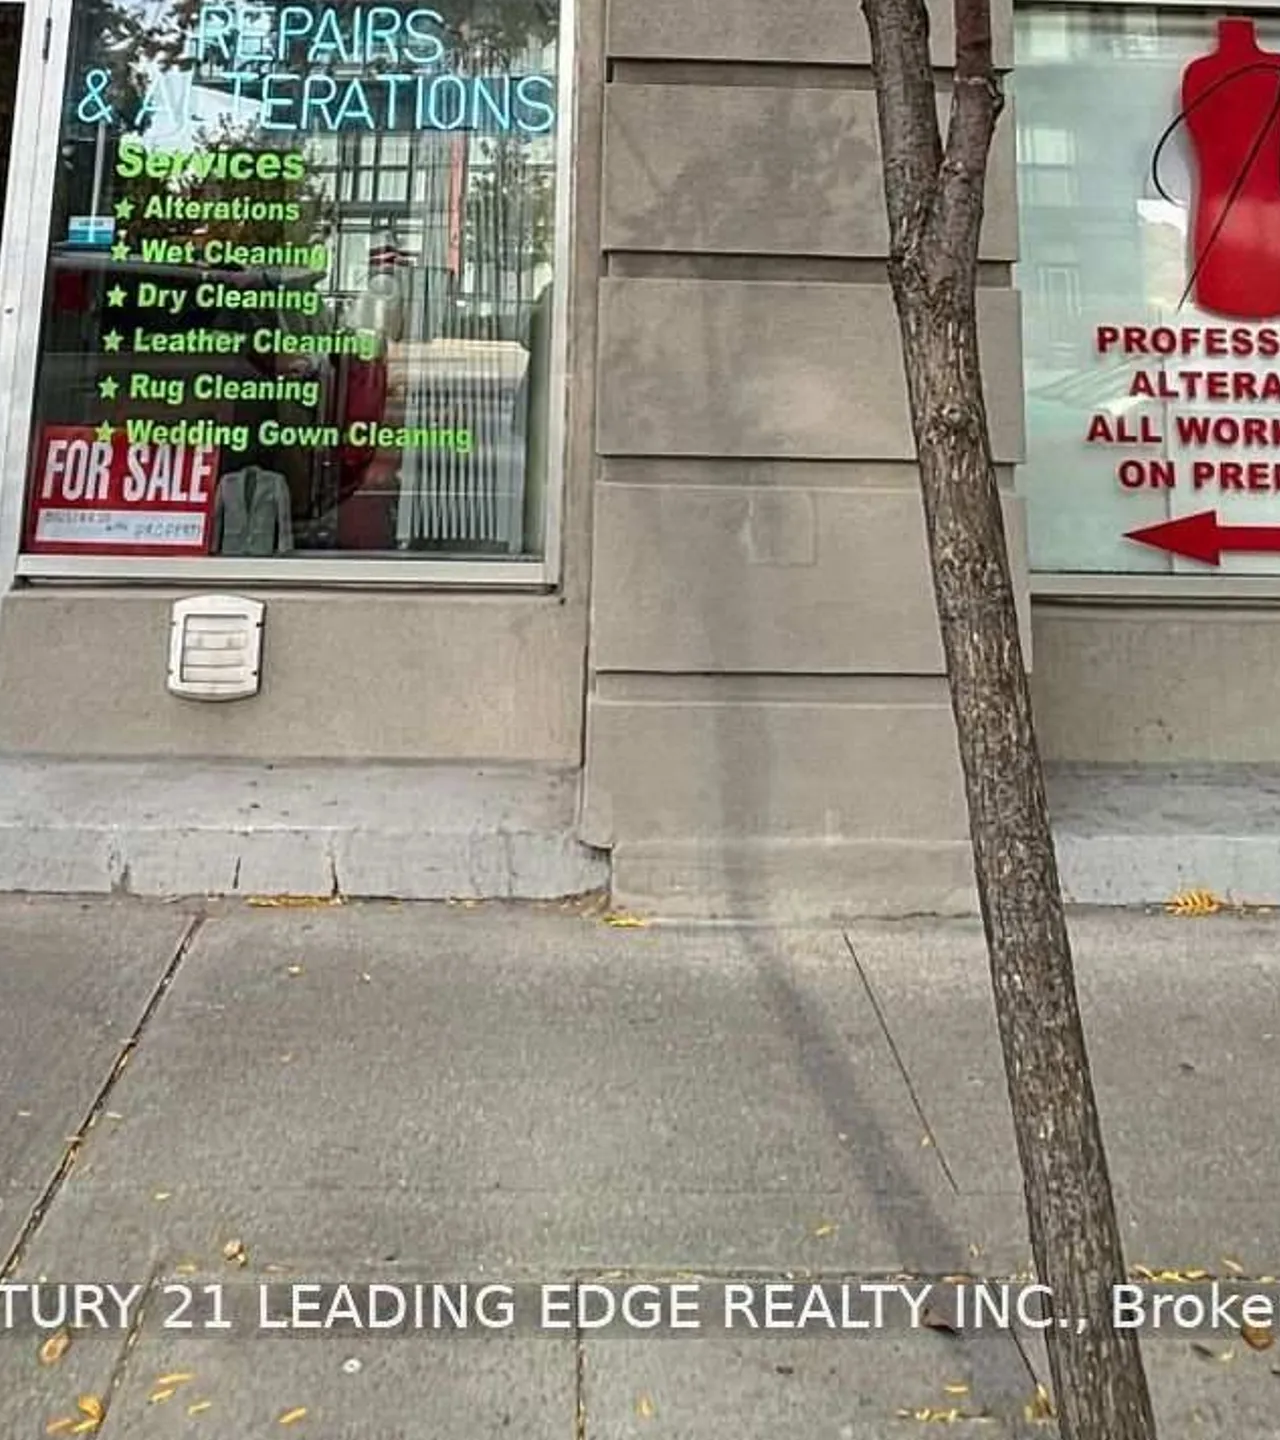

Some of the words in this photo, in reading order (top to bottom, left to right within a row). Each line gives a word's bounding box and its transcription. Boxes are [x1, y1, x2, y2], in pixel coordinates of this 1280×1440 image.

[196, 5, 445, 62] REPAIRS
[78, 69, 114, 124] &
[135, 73, 557, 133] ALTERATIONS
[116, 137, 306, 182] Services
[143, 195, 300, 222] Alterations
[140, 240, 196, 265] Wet
[203, 240, 331, 272] Cleaning
[137, 284, 187, 316] Dry
[194, 284, 322, 317] Cleaning
[132, 328, 245, 355] Leather
[253, 329, 380, 361] Cleaning
[129, 375, 184, 406] Rug
[193, 375, 321, 407] Cleaning
[126, 418, 250, 451] Wedding
[257, 422, 340, 448] Gown
[348, 421, 474, 454] Cleaning
[1086, 415, 1163, 444] ALL
[42, 439, 115, 501] FOR
[122, 440, 214, 503] SALE
[1118, 460, 1176, 489] ON
